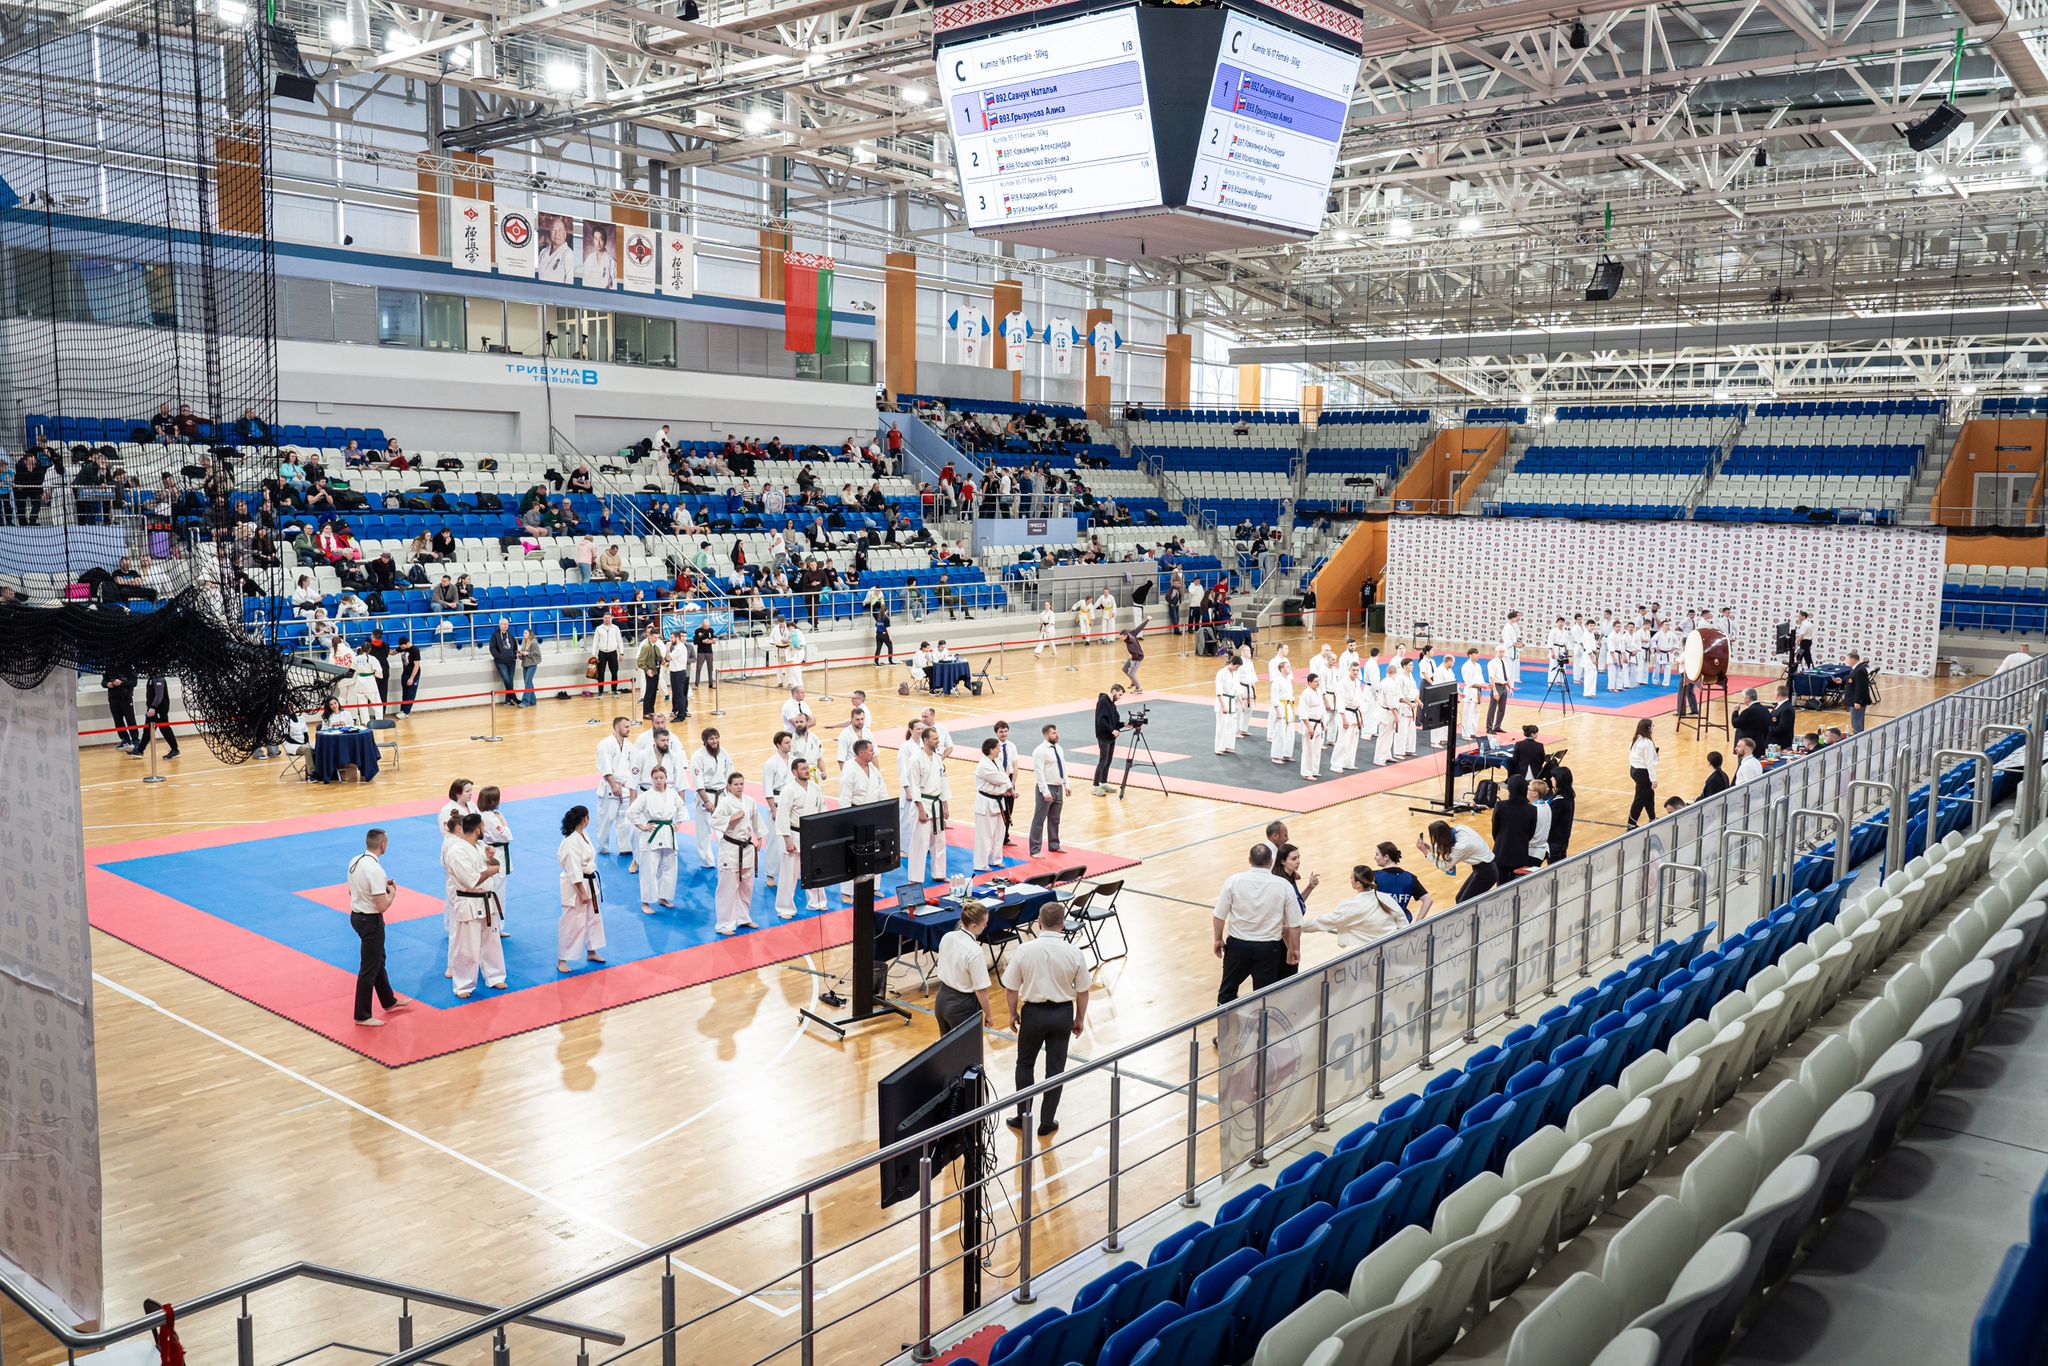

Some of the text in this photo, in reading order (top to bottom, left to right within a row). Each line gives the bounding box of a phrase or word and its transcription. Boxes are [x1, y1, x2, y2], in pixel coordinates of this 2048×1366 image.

[1122, 40, 1133, 52] 1/8
[1231, 30, 1242, 54] C
[980, 60, 998, 70] Kumite
[999, 56, 1012, 66] 16-17
[1013, 52, 1032, 63] Female
[955, 60, 966, 82] C
[996, 85, 1058, 103] 892.Савчук Наталья
[1224, 81, 1228, 97] 1
[965, 107, 971, 123] 1
[998, 106, 1066, 124] 893.Грызунова Алиса
[1211, 128, 1218, 144] 2
[972, 152, 979, 167] 2
[1201, 175, 1208, 191] 3
[979, 195, 986, 210] 3
[967, 327, 972, 337] 7
[1012, 333, 1022, 343] 18
[1057, 338, 1065, 348] 15
[1102, 341, 1107, 351] 2
[506, 364, 580, 377] ТРИБУНА
[533, 375, 580, 384] TRBUNE
[1390, 893, 1410, 903] AFF
